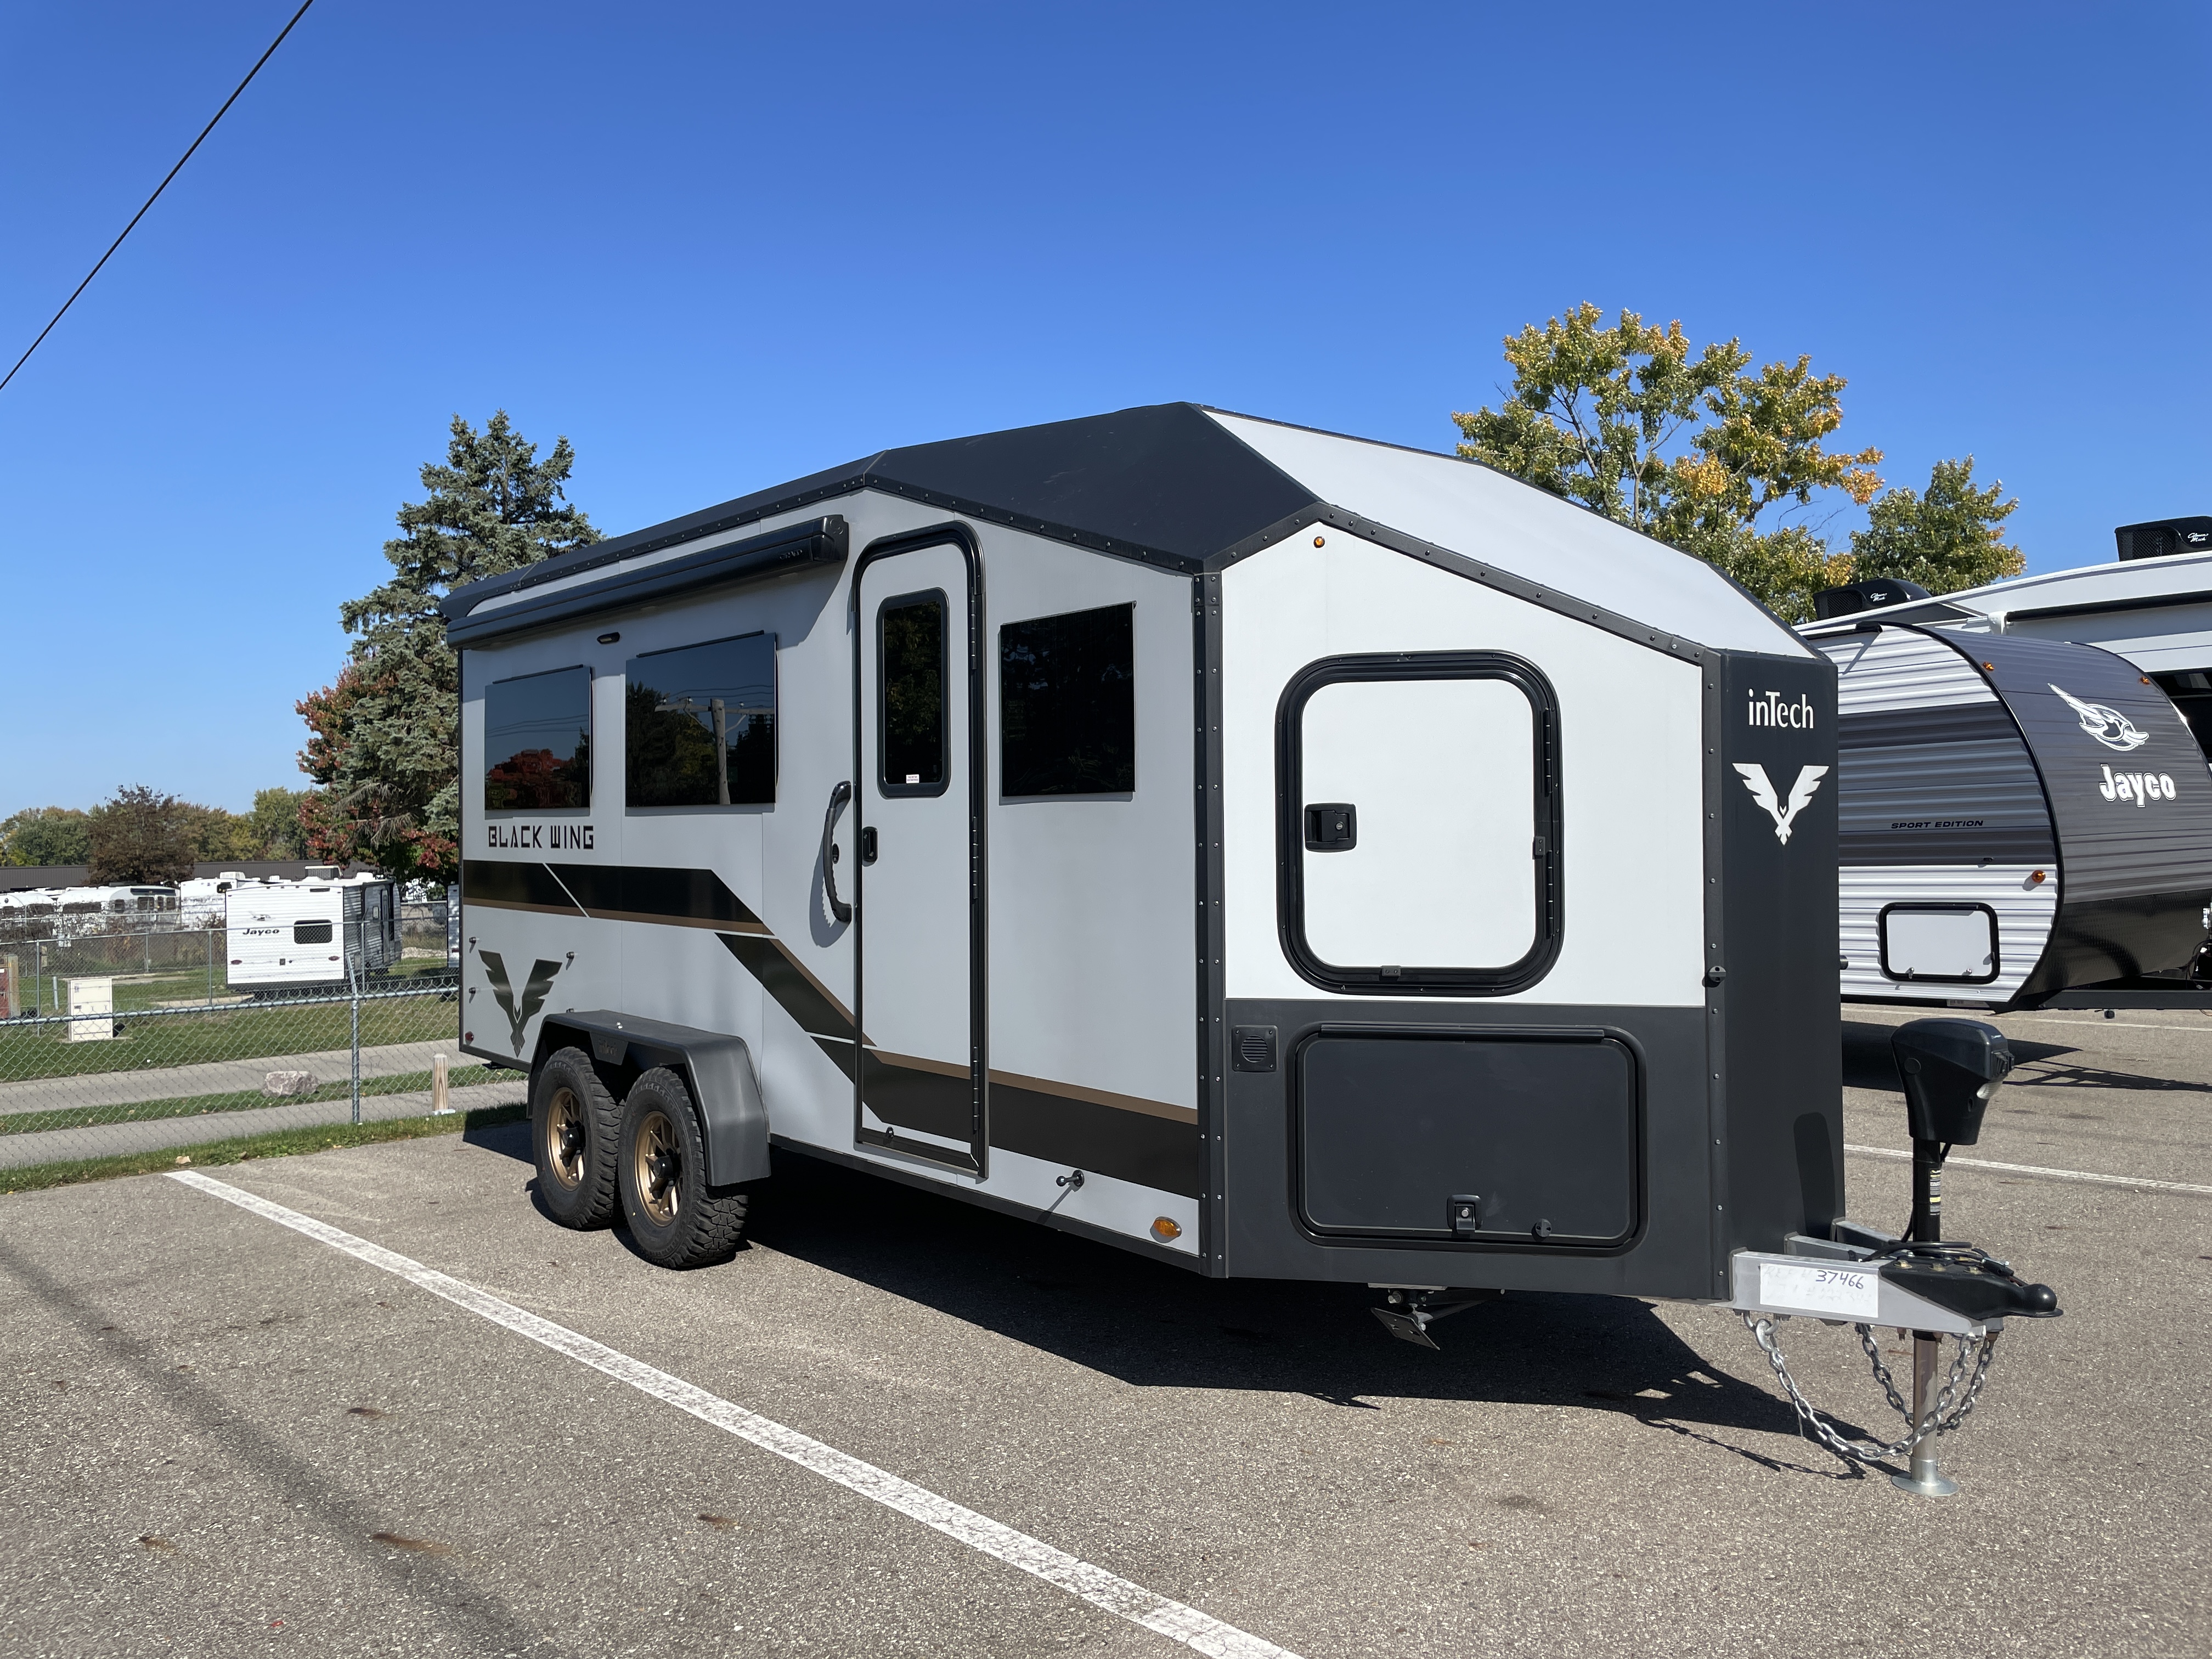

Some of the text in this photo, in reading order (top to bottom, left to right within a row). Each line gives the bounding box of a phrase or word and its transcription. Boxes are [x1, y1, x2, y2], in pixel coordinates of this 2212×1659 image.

[1748, 689, 1814, 729] inTech
[2099, 764, 2176, 808] Jayco
[488, 825, 594, 850] BLACK WING
[1815, 1269, 1864, 1289] 37466
